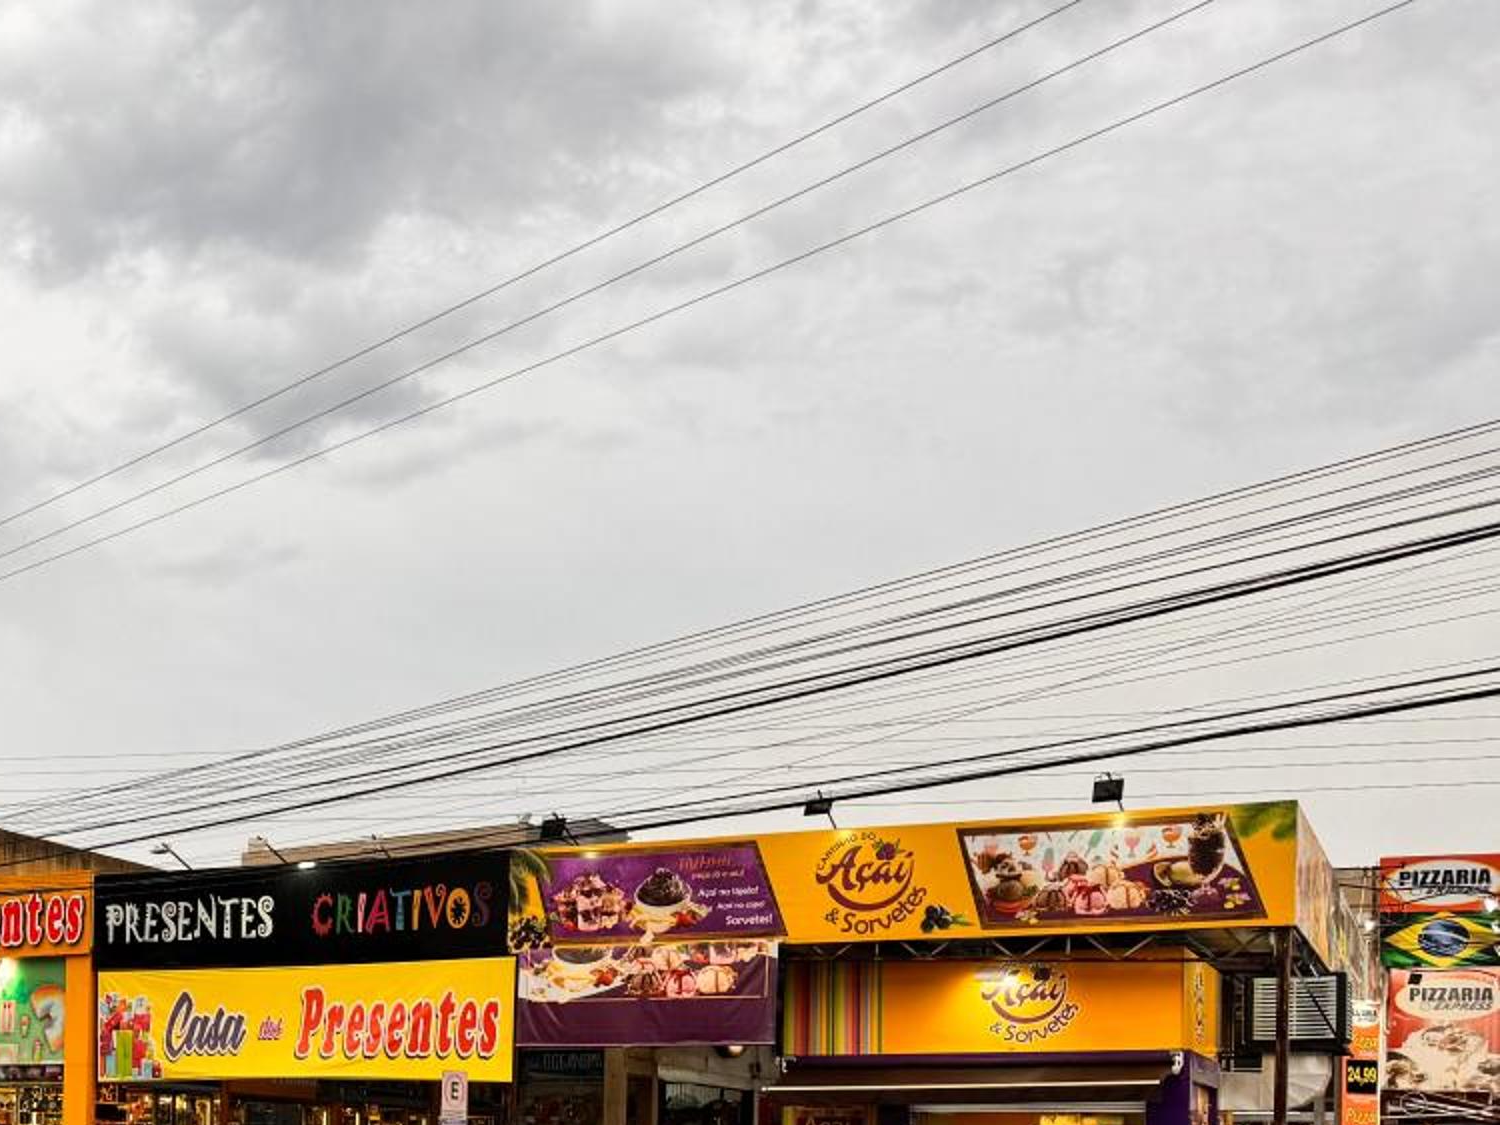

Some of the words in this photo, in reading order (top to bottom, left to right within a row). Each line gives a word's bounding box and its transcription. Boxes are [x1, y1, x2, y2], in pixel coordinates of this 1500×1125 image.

[815, 845, 914, 892] Açaí
[1399, 868, 1492, 886] PIZZARIA
[105, 893, 275, 944] PRESENTES
[311, 881, 493, 937] CRIATIVOS
[725, 913, 773, 926] Sorvetes!
[825, 908, 839, 925] &
[841, 887, 928, 935] Sorvetes
[1409, 987, 1493, 1002] PIZZARIA
[164, 989, 246, 1062] Casa
[295, 986, 499, 1059] Presentes
[1003, 1003, 1079, 1043] Sorvetes
[451, 1081, 459, 1100] E
